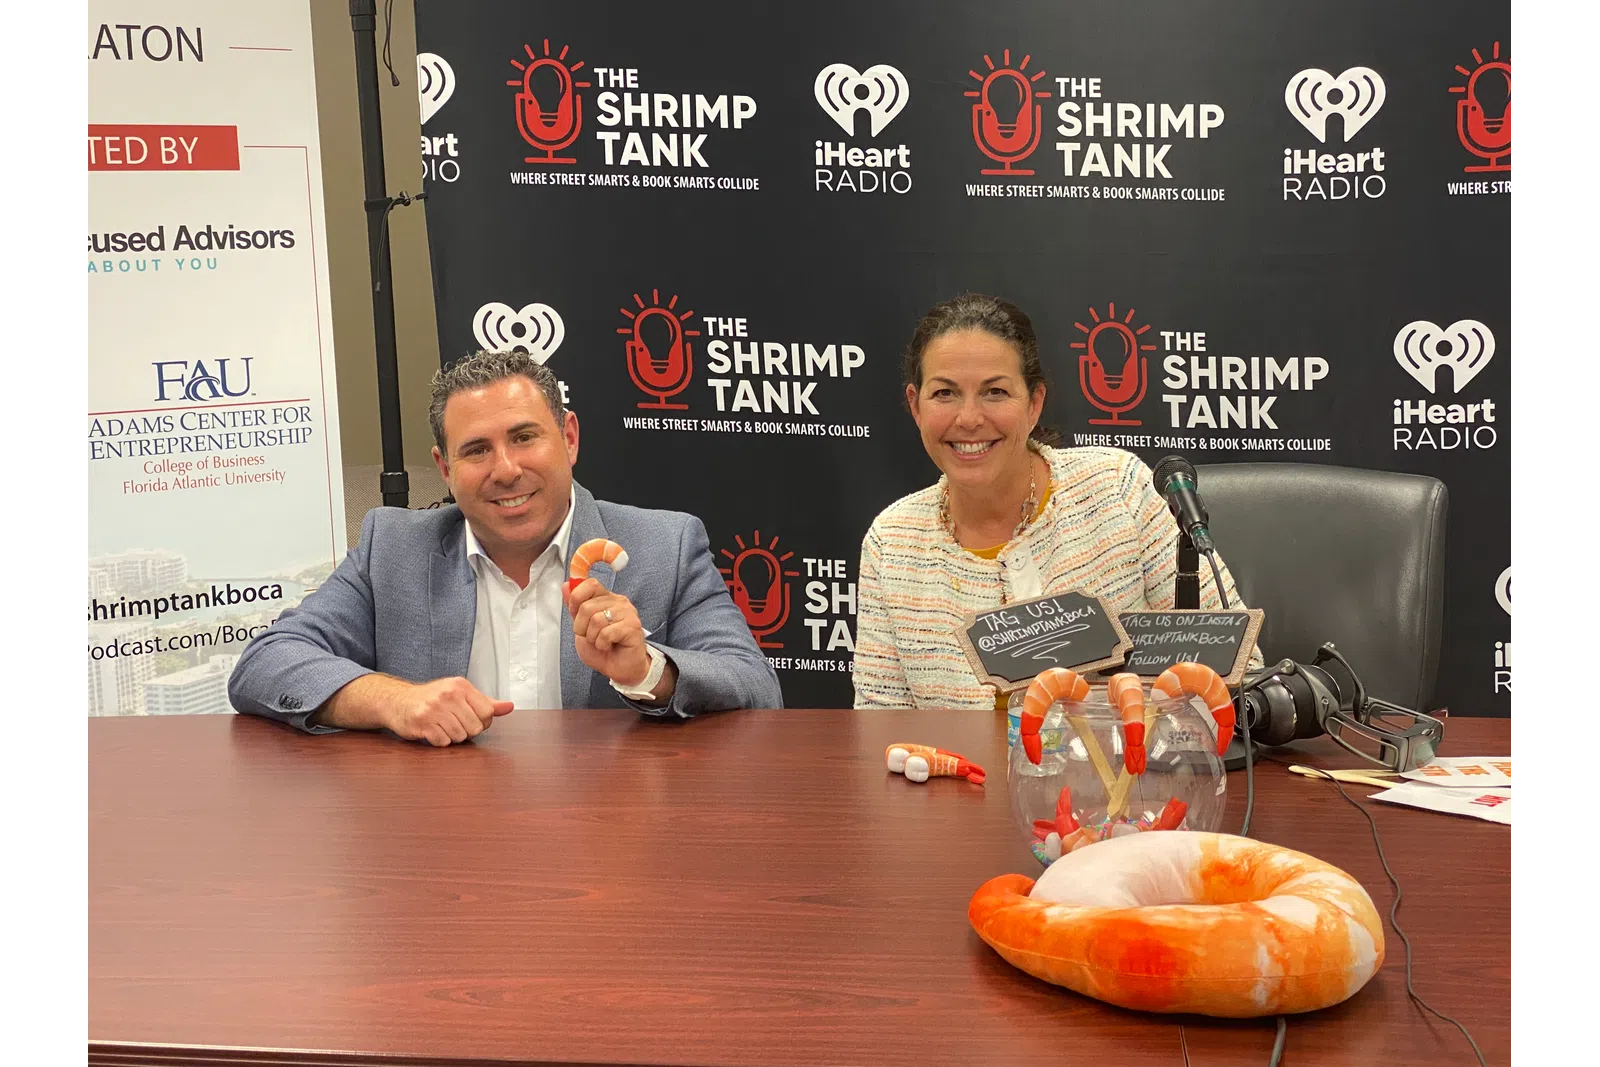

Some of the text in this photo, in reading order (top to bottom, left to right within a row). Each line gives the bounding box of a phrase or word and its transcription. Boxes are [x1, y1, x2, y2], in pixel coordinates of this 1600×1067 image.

[88, 24, 204, 62] ATON
[594, 67, 639, 88] THE
[1055, 77, 1102, 98] THE
[597, 92, 757, 129] SHRIMP
[1056, 102, 1225, 139] SHRIMP
[88, 136, 199, 165] TED BY
[597, 131, 710, 168] TANK
[815, 140, 911, 168] iHeart
[1056, 142, 1173, 179] TANK
[1284, 148, 1385, 175] iHeart
[510, 172, 760, 190] WHERE STREET SMARTS & BOOK SMARTS COLLIDE
[815, 169, 912, 194] RADIO
[965, 184, 1225, 201] WHERE STREET SMARTS & BOOK SMARTS COLLIDE
[1284, 174, 1387, 201] RADIO
[1447, 182, 1489, 195] WHERE
[172, 225, 296, 251] Advisors
[88, 257, 218, 273] ABOUT YOU
[703, 316, 748, 338] THE
[1160, 331, 1206, 352] THE
[706, 340, 866, 378] SHRIMP
[152, 357, 254, 401] FAU
[1162, 355, 1330, 391] SHRIMP
[707, 378, 820, 415] TANK
[88, 406, 312, 438] ADAMS CENTER FOR
[1162, 394, 1279, 429] TANK
[1393, 398, 1496, 425] iHeart
[623, 417, 870, 438] WHERE STREET SMARTS & BOOK SMARTS COLLIDE
[1393, 425, 1497, 451] RADIO
[89, 427, 312, 460] ENTREPRENEURSHIP
[1074, 433, 1332, 451] WHERE STREET SMARTS & BOOK SMARTS COLLIDE
[143, 454, 265, 476] College of Business
[123, 470, 286, 494] Florida Atlantic University
[803, 558, 847, 579] THE
[977, 599, 1064, 632] TAG US!
[978, 605, 1096, 652] @SHRIMPTANKBOCA
[1121, 614, 1151, 628] TAG
[1155, 615, 1172, 628] US
[1175, 615, 1196, 626] ON
[766, 657, 793, 670] REET
[795, 659, 836, 672] SMARTS
[838, 661, 846, 673] &
